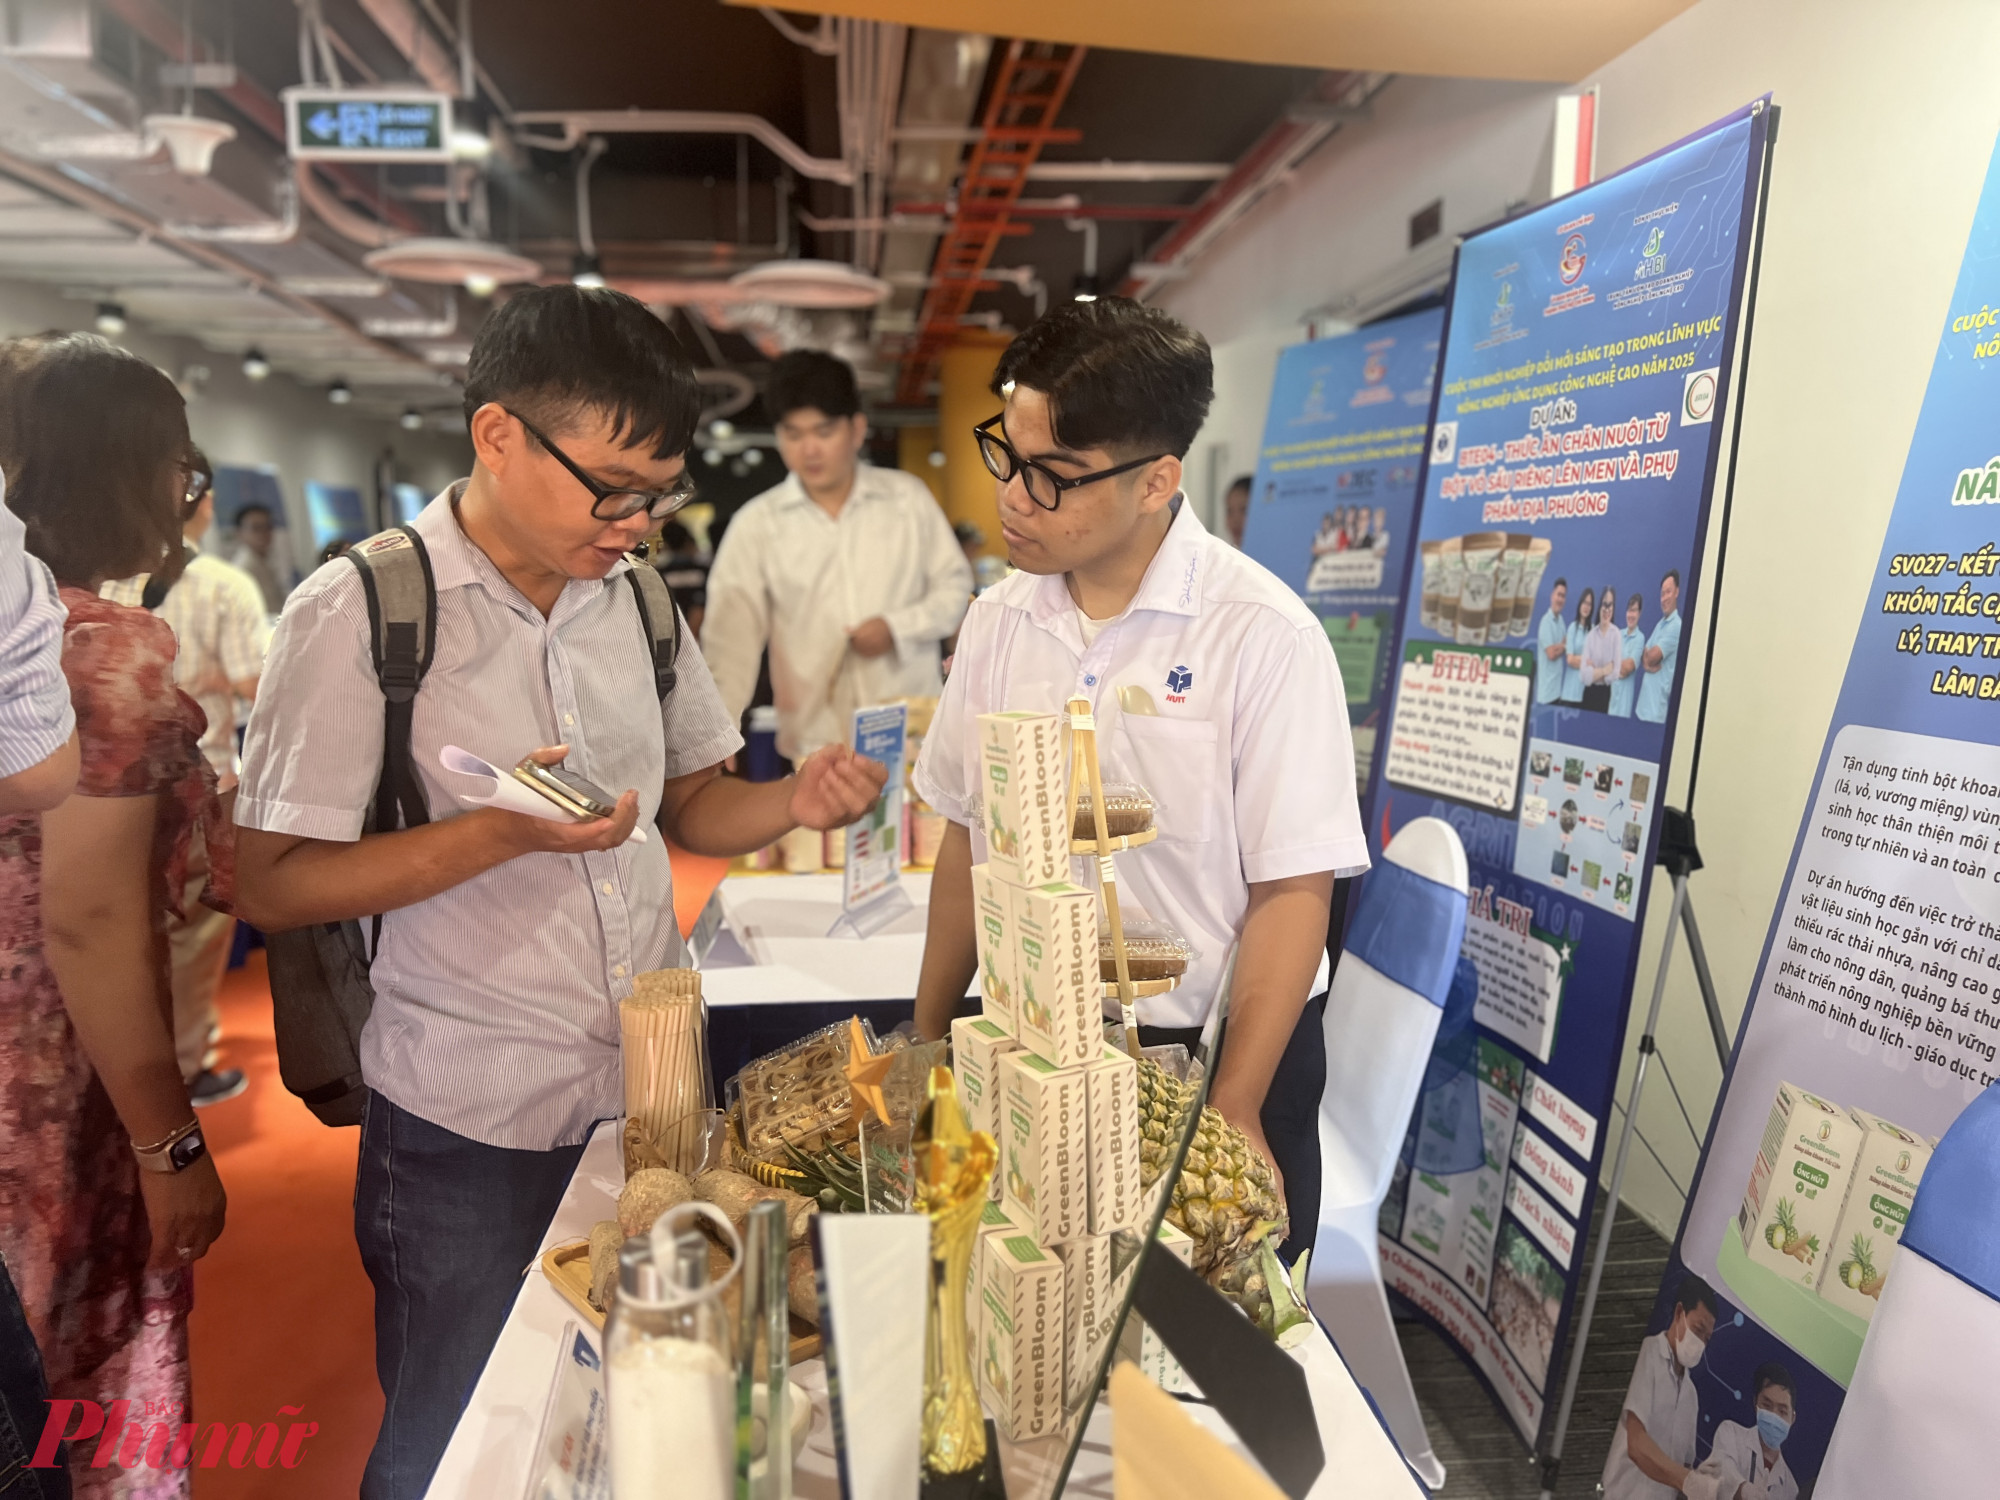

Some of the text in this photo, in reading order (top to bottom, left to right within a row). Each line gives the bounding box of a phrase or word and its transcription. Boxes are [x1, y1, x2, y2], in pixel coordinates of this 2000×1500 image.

[1555, 348, 1574, 370] MỚI
[1575, 345, 1601, 366] SÁNG
[1603, 341, 1625, 362] TẠO
[1627, 331, 1664, 353] TRONG
[1666, 322, 1695, 344] LĨNH
[1697, 316, 1722, 339] VỰC
[1952, 305, 1999, 334] CUỘC
[1973, 333, 2000, 359] NÔ
[1532, 382, 1559, 402] DỤNG
[1560, 373, 1586, 393] CÔNG
[1587, 363, 1617, 388] NGHỆ
[1617, 364, 1640, 382] CAO
[1641, 354, 1668, 376] NĂM
[1669, 352, 1695, 371] 2025
[1504, 432, 1539, 462] THỨC
[1540, 433, 1561, 458] ĂN
[1562, 423, 1603, 454] CHĂN
[1604, 422, 1645, 446] NUÔI
[1646, 412, 1671, 442] TỪ
[1530, 397, 1577, 431] DỰ ÁN:
[1513, 463, 1553, 492] RIÊNG
[1553, 458, 1582, 488] LÊN
[1582, 457, 1617, 485] MEN
[1618, 450, 1641, 481] VÀ
[1641, 448, 1680, 481] PHỤ
[1953, 459, 2000, 503] NÂ
[1521, 495, 1549, 525] ĐỊA
[1548, 491, 1609, 518] PHƯƠNG
[1889, 554, 1948, 576] SV027
[1958, 543, 2000, 576] KẾT
[1883, 582, 1982, 616] KHÓM TẮC
[1897, 624, 1980, 657] LÝ, THAY
[1433, 652, 1491, 685] BTE04
[1932, 666, 1978, 698] LÀM
[1843, 755, 1863, 773] Tận
[1866, 760, 1898, 782] dụng
[1901, 766, 1929, 784] tinh
[1932, 771, 1958, 792] bột
[1033, 724, 1055, 880] GreenBloom
[1827, 802, 1989, 851] sinh học thân thiện môi
[1834, 778, 2000, 832] (lá, vỏ, vương miệng) vùn
[1821, 825, 1986, 879] trong tự nhiên và an toàn
[1470, 884, 1493, 922] IÁ
[1495, 898, 1533, 944] TRỊ
[1807, 869, 1977, 932] Dự án hướng đến việc trở
[1801, 893, 1986, 964] vật liệu sinh học gắn với chỉ
[1787, 935, 1971, 1018] làm cho nông dân, quảng bá
[1794, 914, 1988, 995] thiểu rác thải nhựa, nâng cao
[1069, 902, 1089, 1060] GreenBloom
[1774, 982, 1806, 1006] thành
[1807, 998, 1827, 1015] mô
[1828, 1003, 1857, 1029] hình
[1859, 1018, 1877, 1037] du
[1879, 1025, 1904, 1049] lịch
[1914, 1044, 1947, 1067] giáo
[1949, 1058, 1978, 1081] dục
[1779, 960, 1997, 1063] phát triển nông nghiệp bền vững
[1533, 1086, 1557, 1116] Chất
[1057, 1083, 1070, 1238] GreenBloom
[1112, 1070, 1125, 1225] GreenBloom
[1799, 1134, 1840, 1160] GreenBloom
[1549, 1162, 1575, 1197] hành
[1515, 1186, 1572, 1254] Trách nhiệm
[1029, 1276, 1048, 1436] GreenBloom
